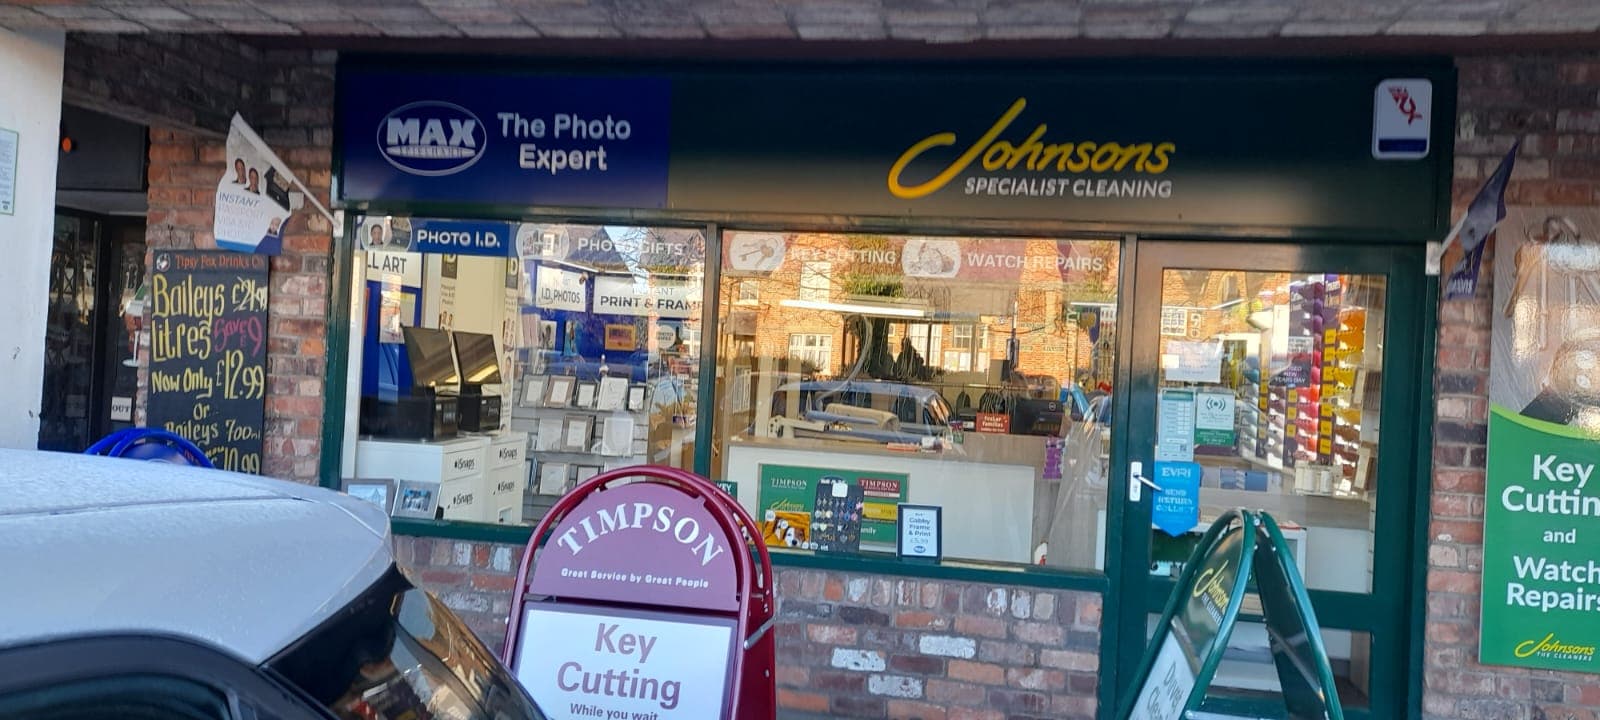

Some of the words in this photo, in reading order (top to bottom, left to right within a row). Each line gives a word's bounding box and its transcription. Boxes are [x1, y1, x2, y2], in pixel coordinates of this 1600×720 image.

[386, 118, 476, 147] MAX
[498, 113, 545, 138] The
[554, 114, 631, 139] Photo
[888, 97, 1176, 199] Johnsons
[519, 143, 608, 174] Expert
[965, 177, 1069, 196] SPECIALIST
[1072, 178, 1173, 198] CLEANING
[218, 191, 260, 208] INSTANT
[417, 229, 470, 246] PHOTO
[475, 231, 500, 247] I.D.
[578, 237, 632, 252] PHOTO
[640, 239, 684, 255] GIFTS
[382, 254, 407, 274] ART
[790, 248, 820, 262] KEY
[825, 248, 896, 264] CUTTING
[967, 253, 1025, 270] WATCH
[1031, 254, 1103, 271] REPAIRS
[152, 274, 225, 325] Baileys
[553, 288, 581, 305] PHOTOS
[600, 295, 640, 307] PRINT
[151, 318, 212, 362] Litres
[112, 404, 131, 413] OUT
[1162, 467, 1191, 478] EVRI
[1532, 454, 1595, 488] Key
[770, 477, 807, 488] TIMPSON
[861, 479, 898, 490] TIMPSON
[1501, 485, 1600, 517] Cuttin
[557, 502, 723, 567] TIMPSON
[1543, 529, 1577, 544] and
[561, 568, 588, 579] Great
[590, 570, 627, 582] Service
[629, 572, 642, 584] by
[645, 575, 672, 586] Great
[675, 577, 709, 589] People
[1513, 555, 1600, 584] Watch
[594, 623, 657, 663] Key
[1514, 633, 1595, 658] Johnsons
[1553, 653, 1592, 661] CLEANERS
[557, 661, 681, 710] Cutting
[570, 703, 603, 717] While
[606, 708, 628, 720] you
